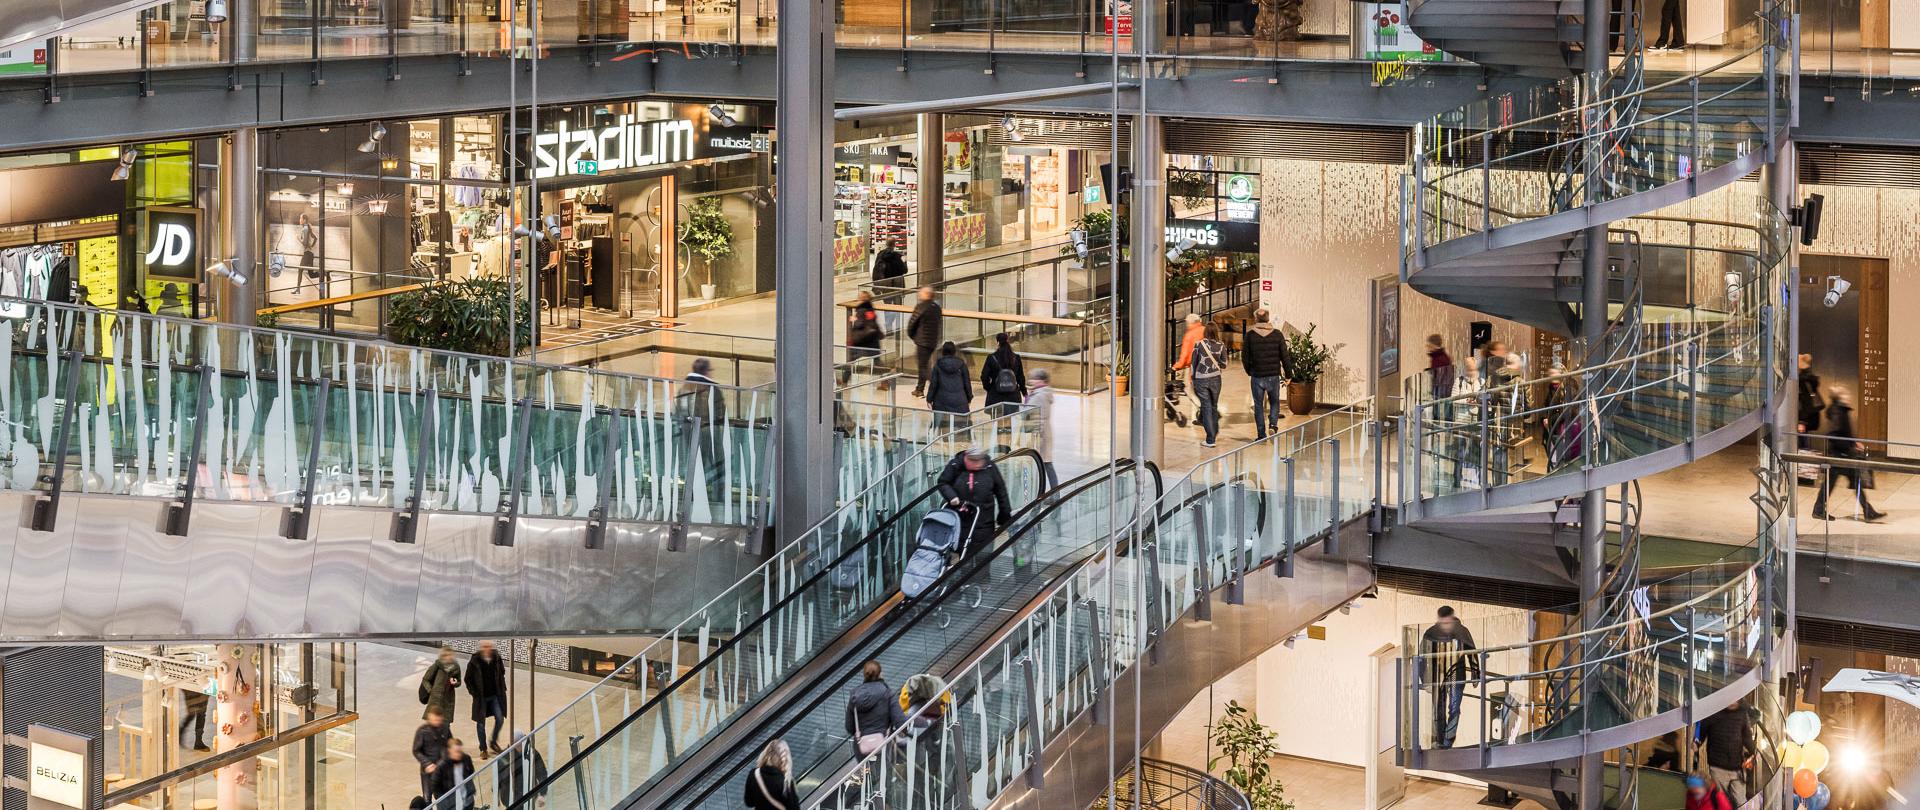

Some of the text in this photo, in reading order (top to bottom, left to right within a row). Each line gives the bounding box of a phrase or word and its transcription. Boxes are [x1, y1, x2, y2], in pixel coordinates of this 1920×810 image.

[529, 114, 694, 179] stadium
[755, 139, 762, 149] 2
[146, 223, 191, 266] JD
[36, 766, 77, 784] BELIZIA
